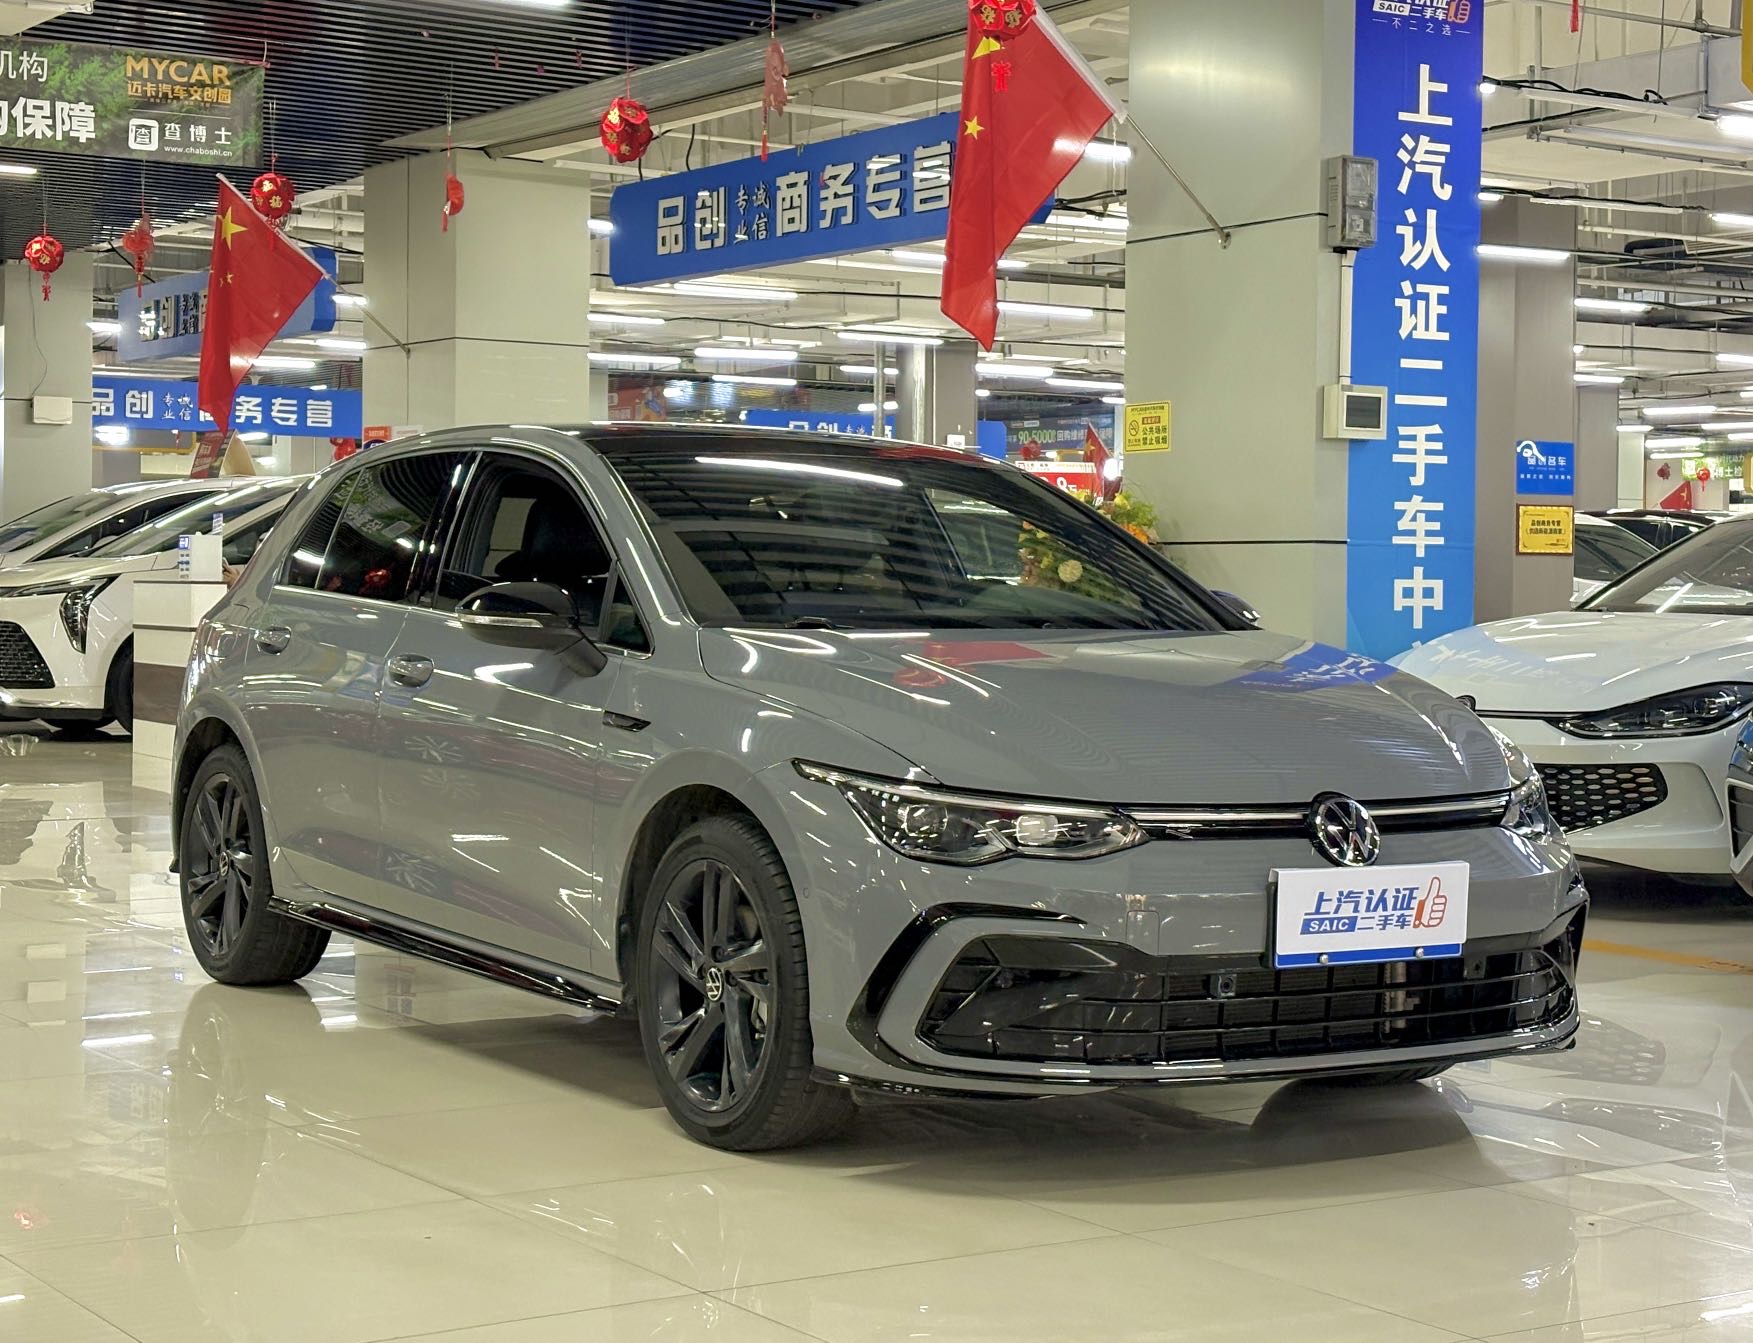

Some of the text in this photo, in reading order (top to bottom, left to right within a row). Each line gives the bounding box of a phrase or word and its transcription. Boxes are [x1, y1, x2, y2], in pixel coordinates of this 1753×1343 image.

[1378, 2, 1405, 13] SAIC
[1409, 5, 1448, 20] 二手车
[1392, 17, 1451, 35] 不二之选
[126, 55, 231, 85] MYCAR
[127, 80, 232, 104] 迈卡汽车文创园
[164, 122, 232, 145] 查博士
[164, 146, 232, 157] www.chaboshi.cn
[656, 140, 953, 256] 品创 商务专营
[1392, 63, 1454, 648] 上汽认证二手车中
[92, 388, 154, 419] 品创
[1304, 886, 1420, 917] 上汽认证
[1308, 918, 1351, 932] SAIC
[1357, 913, 1414, 931] 二手车
